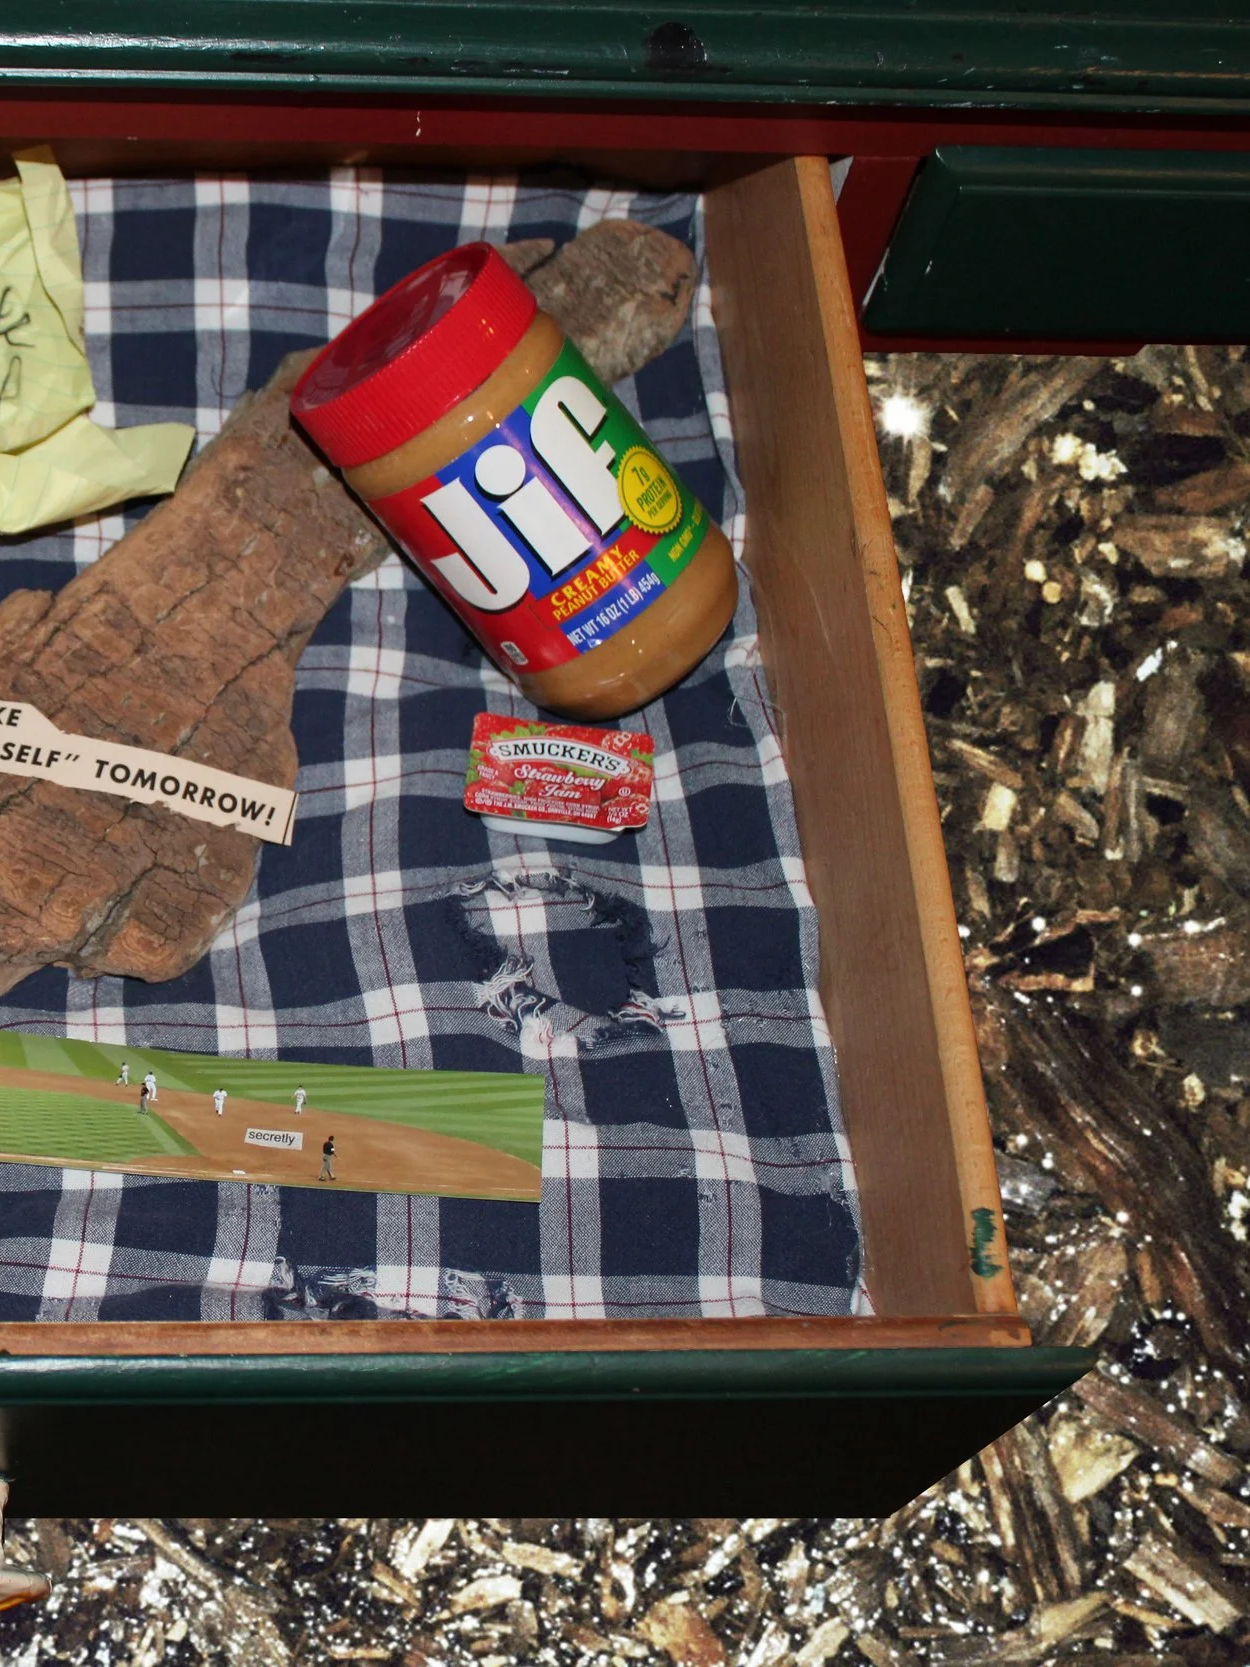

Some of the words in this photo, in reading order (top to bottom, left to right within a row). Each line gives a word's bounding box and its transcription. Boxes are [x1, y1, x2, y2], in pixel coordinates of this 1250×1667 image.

[419, 376, 626, 613] Jif
[632, 466, 650, 486] 7g
[636, 475, 667, 512] PROTEIN
[551, 545, 623, 607] CREAMY
[553, 584, 599, 621] PEANUT
[598, 549, 640, 589] BUTTER
[566, 628, 586, 647] NET
[581, 619, 600, 637] WT
[596, 612, 610, 628] 16
[605, 603, 622, 621] OZ
[617, 596, 630, 614] (1
[624, 586, 645, 606] LB)
[638, 572, 661, 594] 454g
[499, 742, 621, 772] SMUCKER'S
[93, 760, 276, 827] TOMORROW!
[514, 764, 607, 790] Strawberry
[538, 783, 582, 799] Jam
[248, 1131, 296, 1146] secretly
